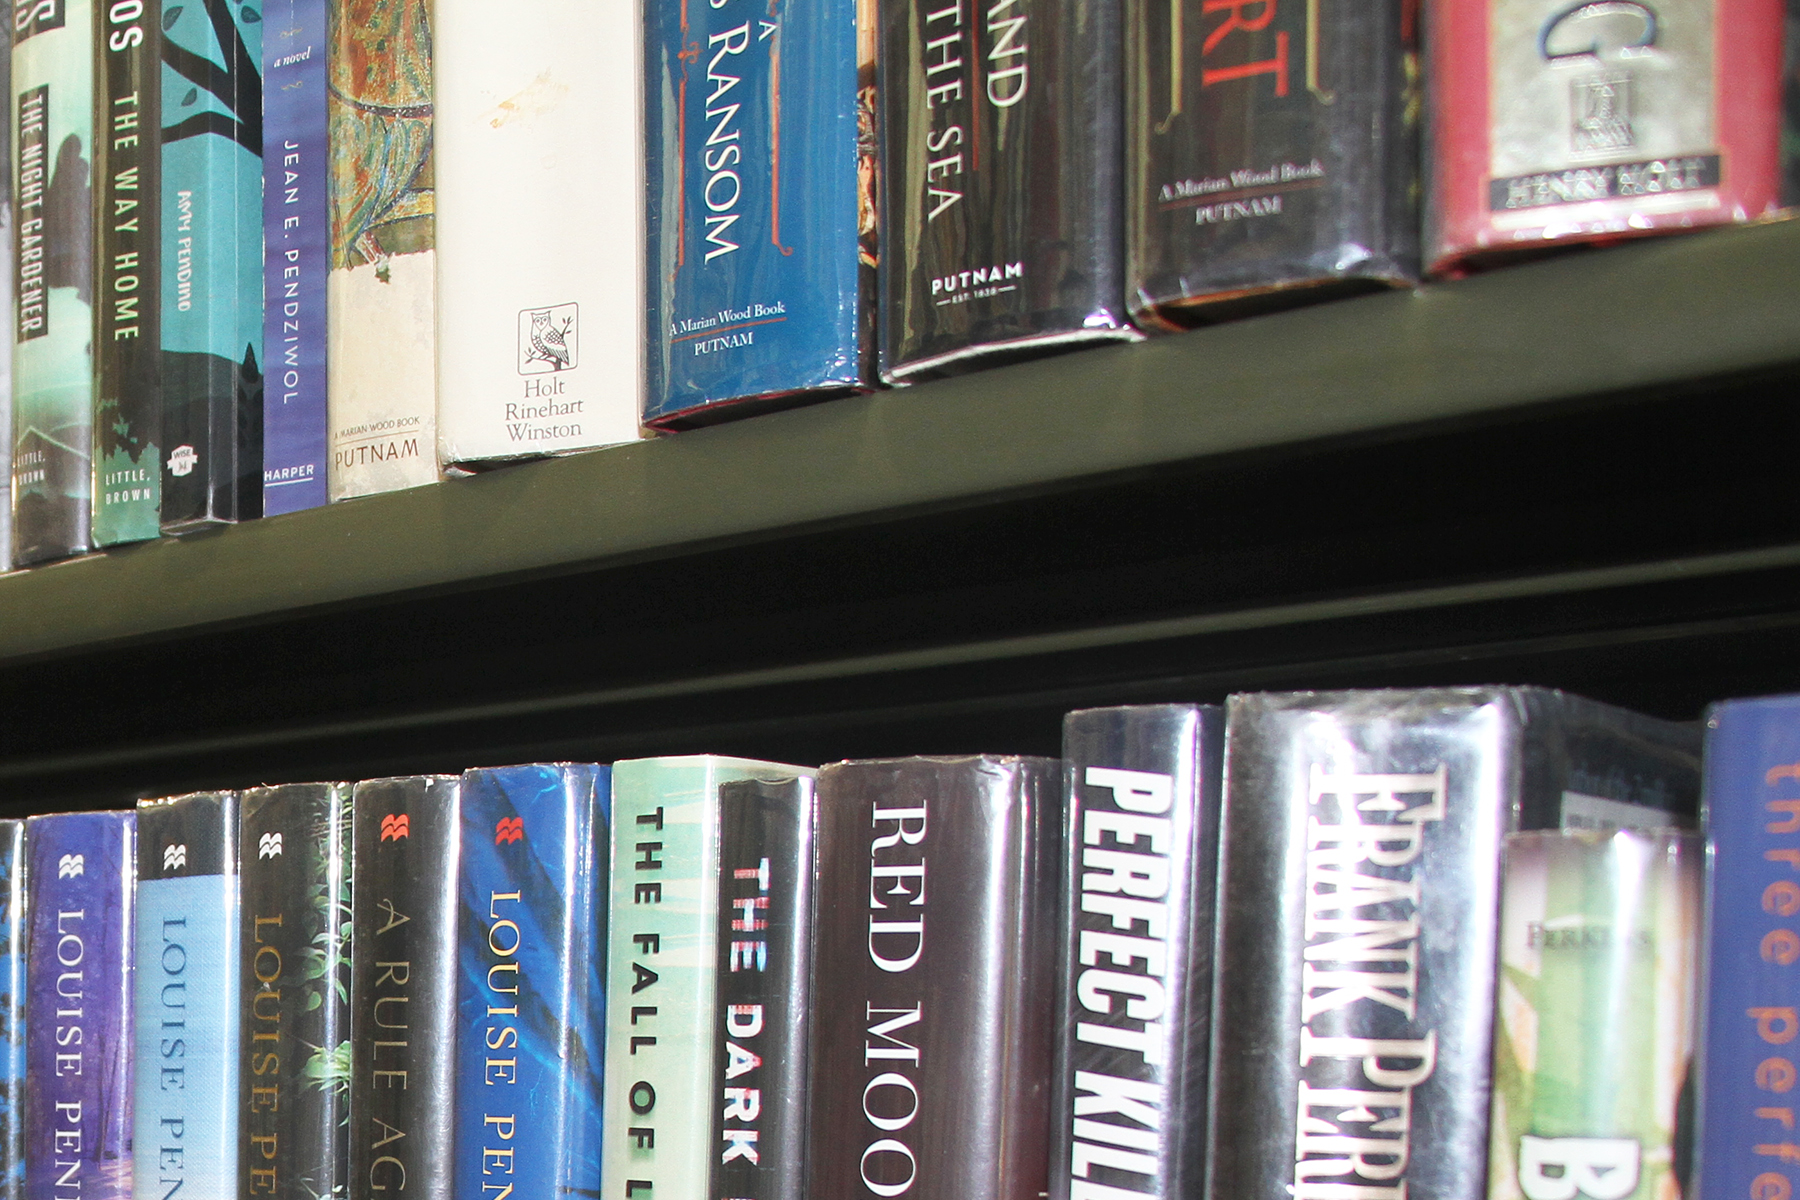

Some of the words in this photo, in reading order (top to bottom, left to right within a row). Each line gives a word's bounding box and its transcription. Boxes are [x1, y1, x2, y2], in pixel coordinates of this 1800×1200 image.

[283, 46, 312, 66] novel
[21, 94, 43, 138] THE
[114, 90, 139, 152] THE
[703, 20, 751, 266] RANSOM
[21, 143, 43, 211] NIGHT
[114, 166, 139, 233] WAY
[283, 139, 300, 206] JEAN
[927, 123, 964, 224] SEA
[1281, 157, 1326, 181] Book
[176, 190, 192, 234] AMY
[283, 217, 300, 240] E.
[1194, 194, 1284, 226] PUTNAM
[19, 217, 43, 333] GARDENER
[114, 251, 139, 342] HOME
[931, 260, 1025, 297] PUTNAM
[283, 249, 300, 405] PENDZIWOL
[679, 314, 717, 334] Marian
[717, 303, 753, 326] Wood
[753, 298, 786, 320] Book
[693, 331, 754, 357] PUTNAM
[504, 398, 584, 422] Rinehart
[523, 377, 565, 399] Holt
[334, 437, 420, 472] PUTNAM
[505, 419, 583, 443] Winston
[105, 488, 151, 506] BROWN
[263, 463, 315, 482] HARPER
[633, 806, 665, 906] THE
[866, 799, 928, 974] RED
[1759, 762, 1800, 965] three
[729, 856, 772, 974] THE
[1074, 764, 1175, 1067] PERFECT
[1302, 762, 1448, 1023] FRANK
[54, 908, 85, 1077] LOUISE
[159, 915, 187, 1093] LOUISE
[484, 889, 522, 1087] LOUISE
[630, 932, 660, 1056] FALL
[371, 960, 411, 1091] RULE
[626, 1079, 657, 1150] OF
[721, 1003, 765, 1166] DARK
